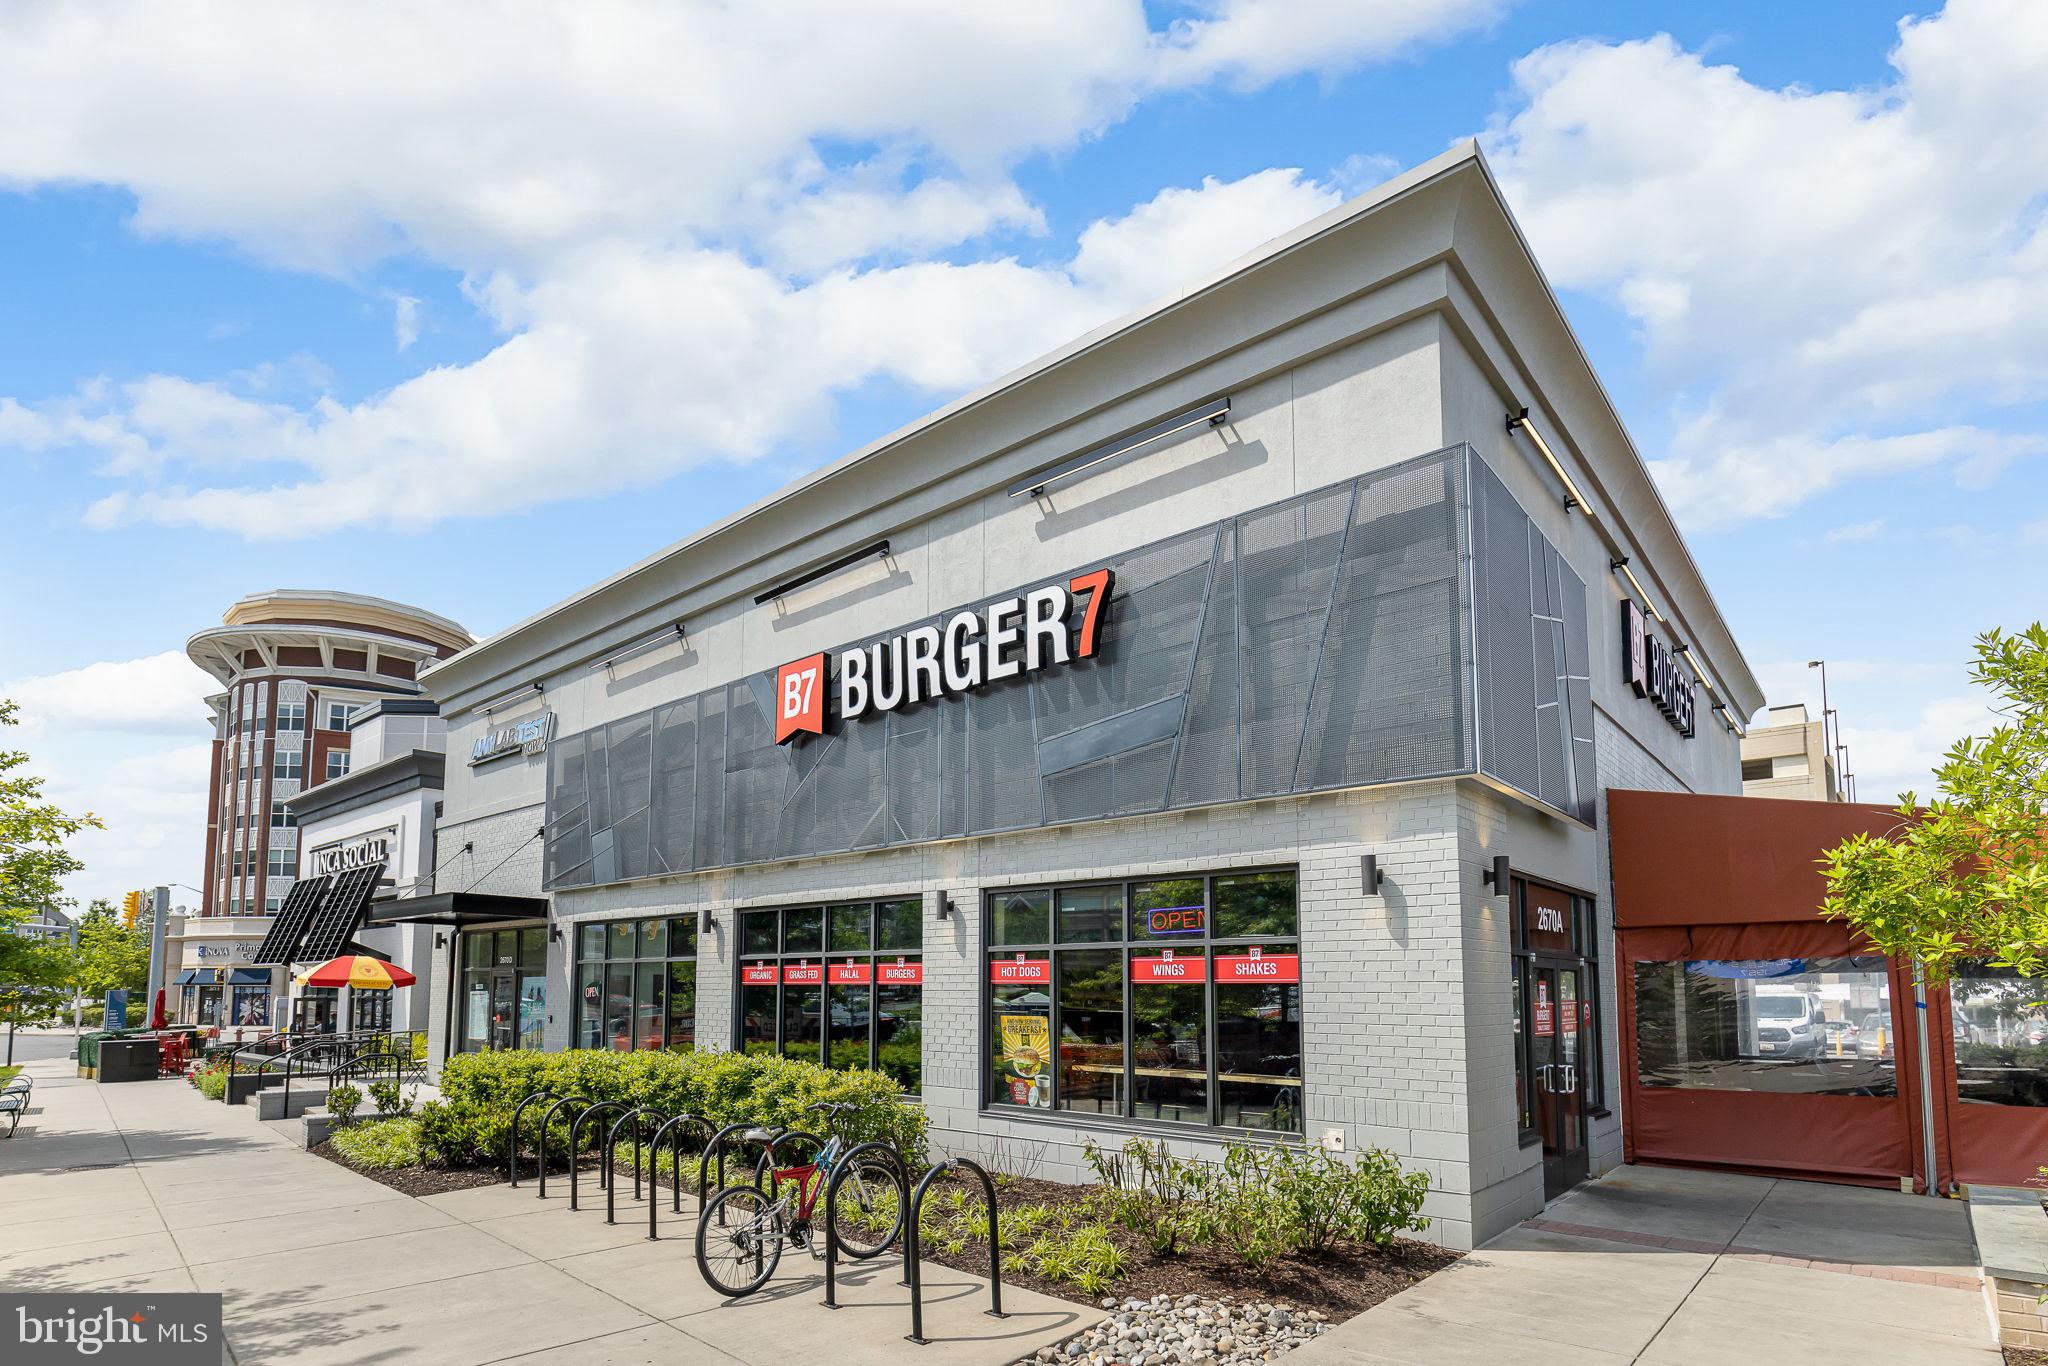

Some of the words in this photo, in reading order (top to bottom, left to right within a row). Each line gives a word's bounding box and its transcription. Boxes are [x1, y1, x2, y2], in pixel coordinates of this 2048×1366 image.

[783, 668, 817, 719] B7
[315, 850, 341, 874] INCA
[342, 839, 385, 869] SOCIAL
[1537, 906, 1564, 933] 2670A
[205, 946, 229, 957] INOVA
[789, 970, 807, 979] GRASS
[807, 970, 818, 979] FED
[840, 969, 860, 979] HALAL
[886, 969, 916, 979] BURGERS
[1001, 966, 1017, 977] HOT
[1019, 966, 1041, 977] DOGS
[1152, 964, 1185, 976] WINGS
[1235, 963, 1277, 975] SHAKES
[749, 971, 773, 980] ORGANIC
[585, 986, 599, 998] OPEN
[1008, 1025, 1042, 1034] BREAKFAST
